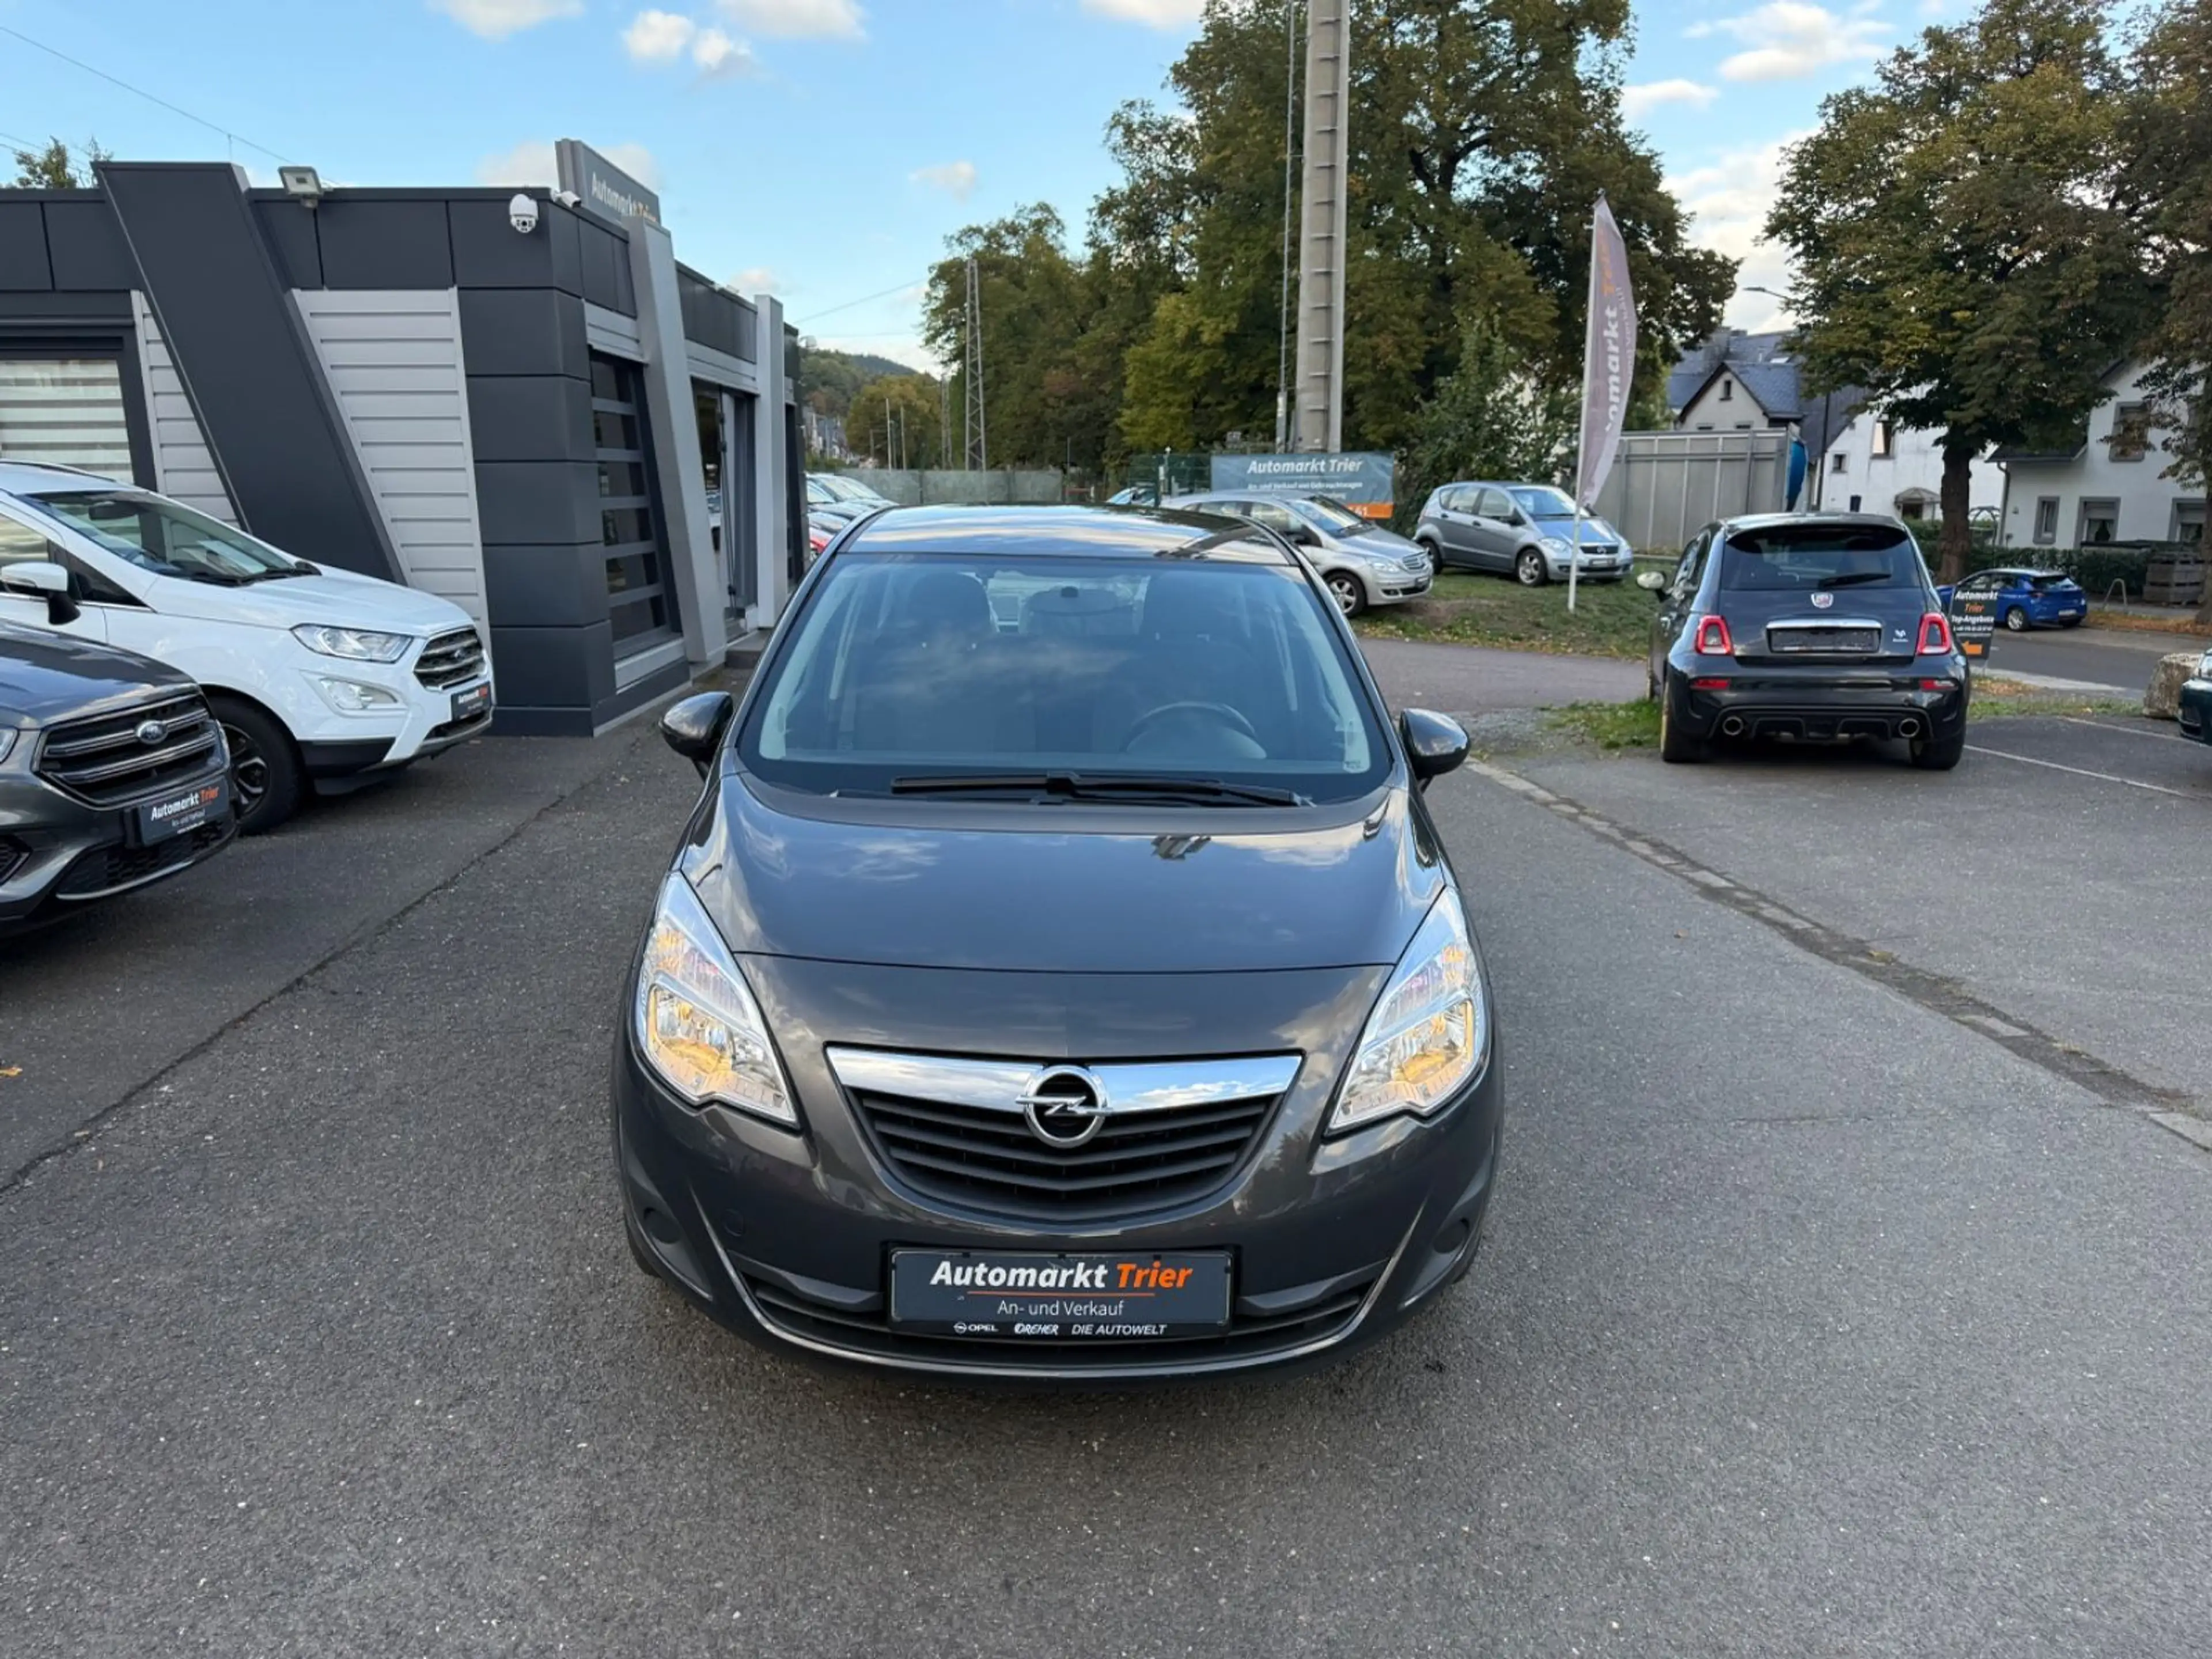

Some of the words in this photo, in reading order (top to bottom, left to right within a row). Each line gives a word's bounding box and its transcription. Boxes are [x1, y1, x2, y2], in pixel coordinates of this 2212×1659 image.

[1247, 459, 1325, 474] Automarkt
[1329, 457, 1363, 472] Trier
[151, 793, 199, 821] Automarkt
[930, 1261, 1108, 1288] Automarkt
[1116, 1260, 1194, 1288] Trier
[997, 1300, 1025, 1315] An-
[1028, 1300, 1059, 1316] und
[1063, 1300, 1124, 1316] Verkauf
[1071, 1324, 1094, 1335] DIE
[1095, 1324, 1168, 1335] AUTOWELT
